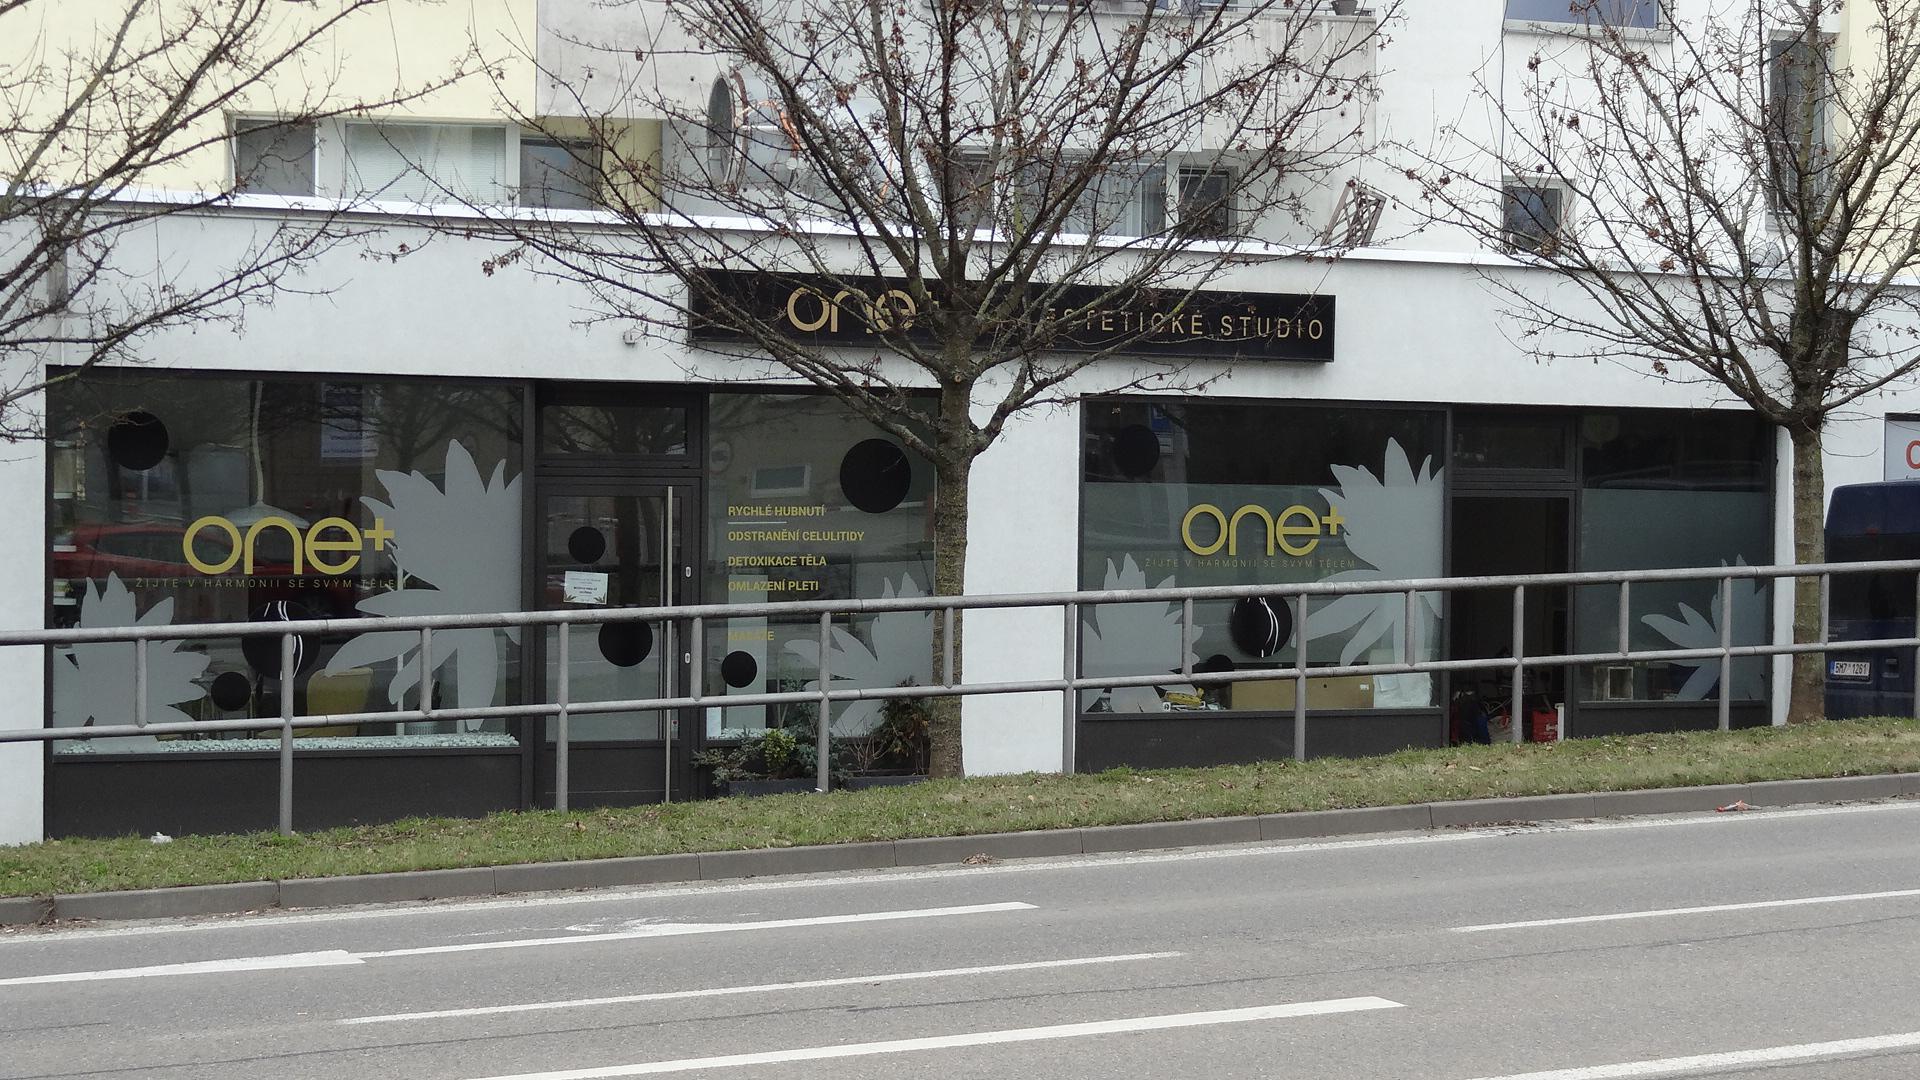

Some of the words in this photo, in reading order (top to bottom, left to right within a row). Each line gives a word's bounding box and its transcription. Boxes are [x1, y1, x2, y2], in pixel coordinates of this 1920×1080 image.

[787, 286, 939, 334] one
[1221, 315, 1323, 340] STUDIO
[728, 504, 772, 517] RYCHLÉ
[774, 503, 825, 517] HUBNUTÍ
[728, 528, 800, 541] ODSTRANĚNÍ
[802, 531, 865, 541] CELULITIDY
[1181, 503, 1345, 557] one+
[183, 515, 395, 575] one+
[728, 556, 797, 567] DETOXIKACE
[799, 553, 827, 566] TĚLA
[1185, 559, 1192, 568] V
[1263, 558, 1277, 568] SE
[135, 578, 179, 589] ŽIJTE
[188, 579, 196, 589] V
[204, 579, 280, 589] HARMONII
[288, 579, 305, 589] SE
[313, 577, 352, 589] SVÝM
[728, 579, 786, 592] OMLAZENÍ
[788, 581, 819, 591] PLETI
[1852, 663, 1867, 675] 1261
